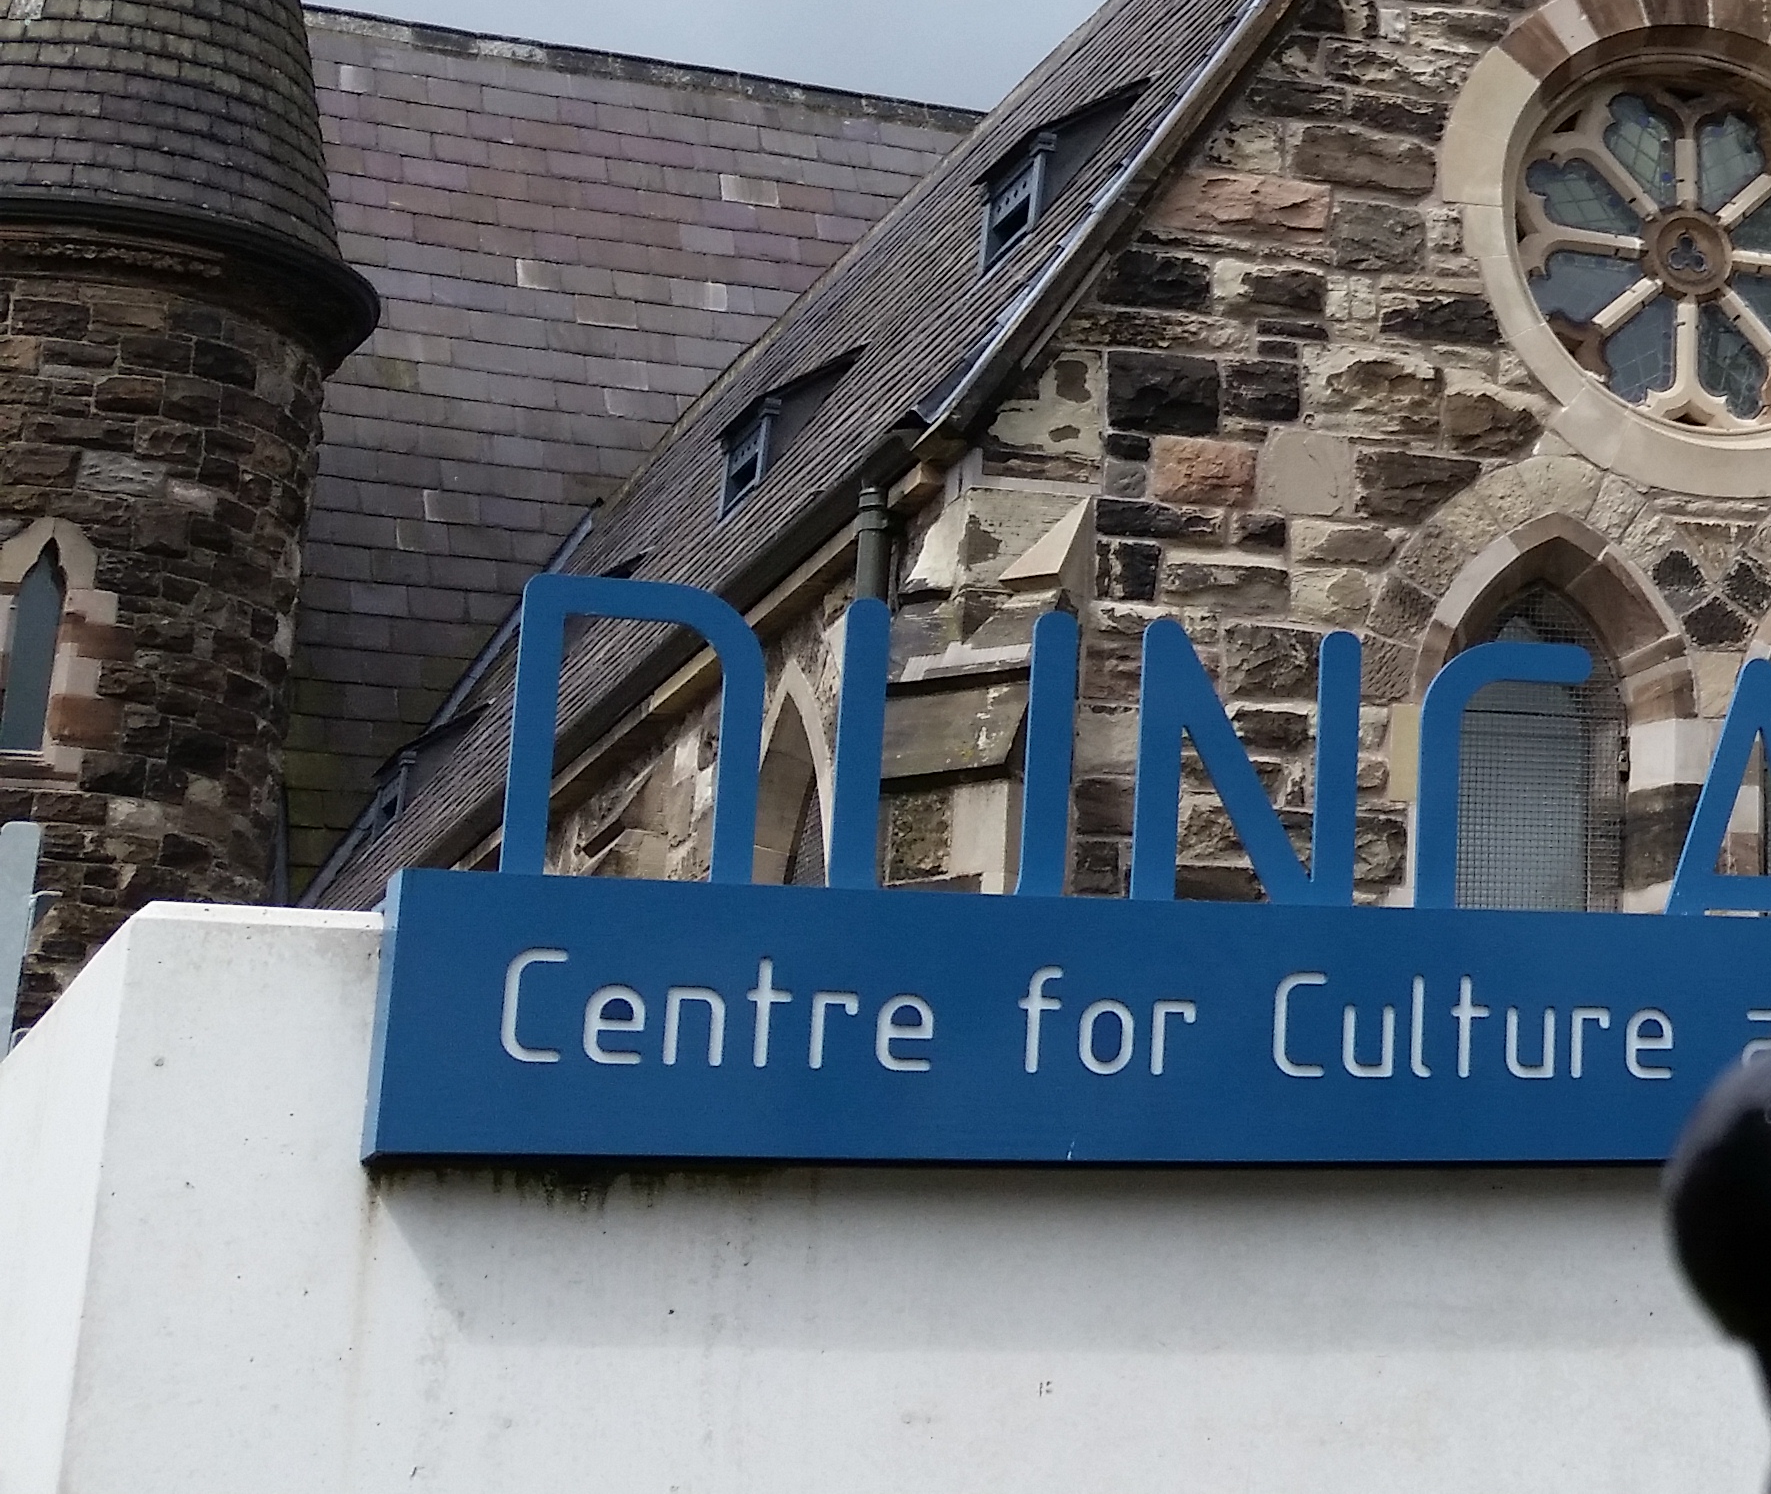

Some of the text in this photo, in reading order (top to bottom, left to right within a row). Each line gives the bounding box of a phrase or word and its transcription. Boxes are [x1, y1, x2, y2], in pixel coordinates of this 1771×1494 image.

[499, 948, 935, 1073] Centre
[1018, 966, 1196, 1076] for
[1272, 972, 1675, 1080] Culture
